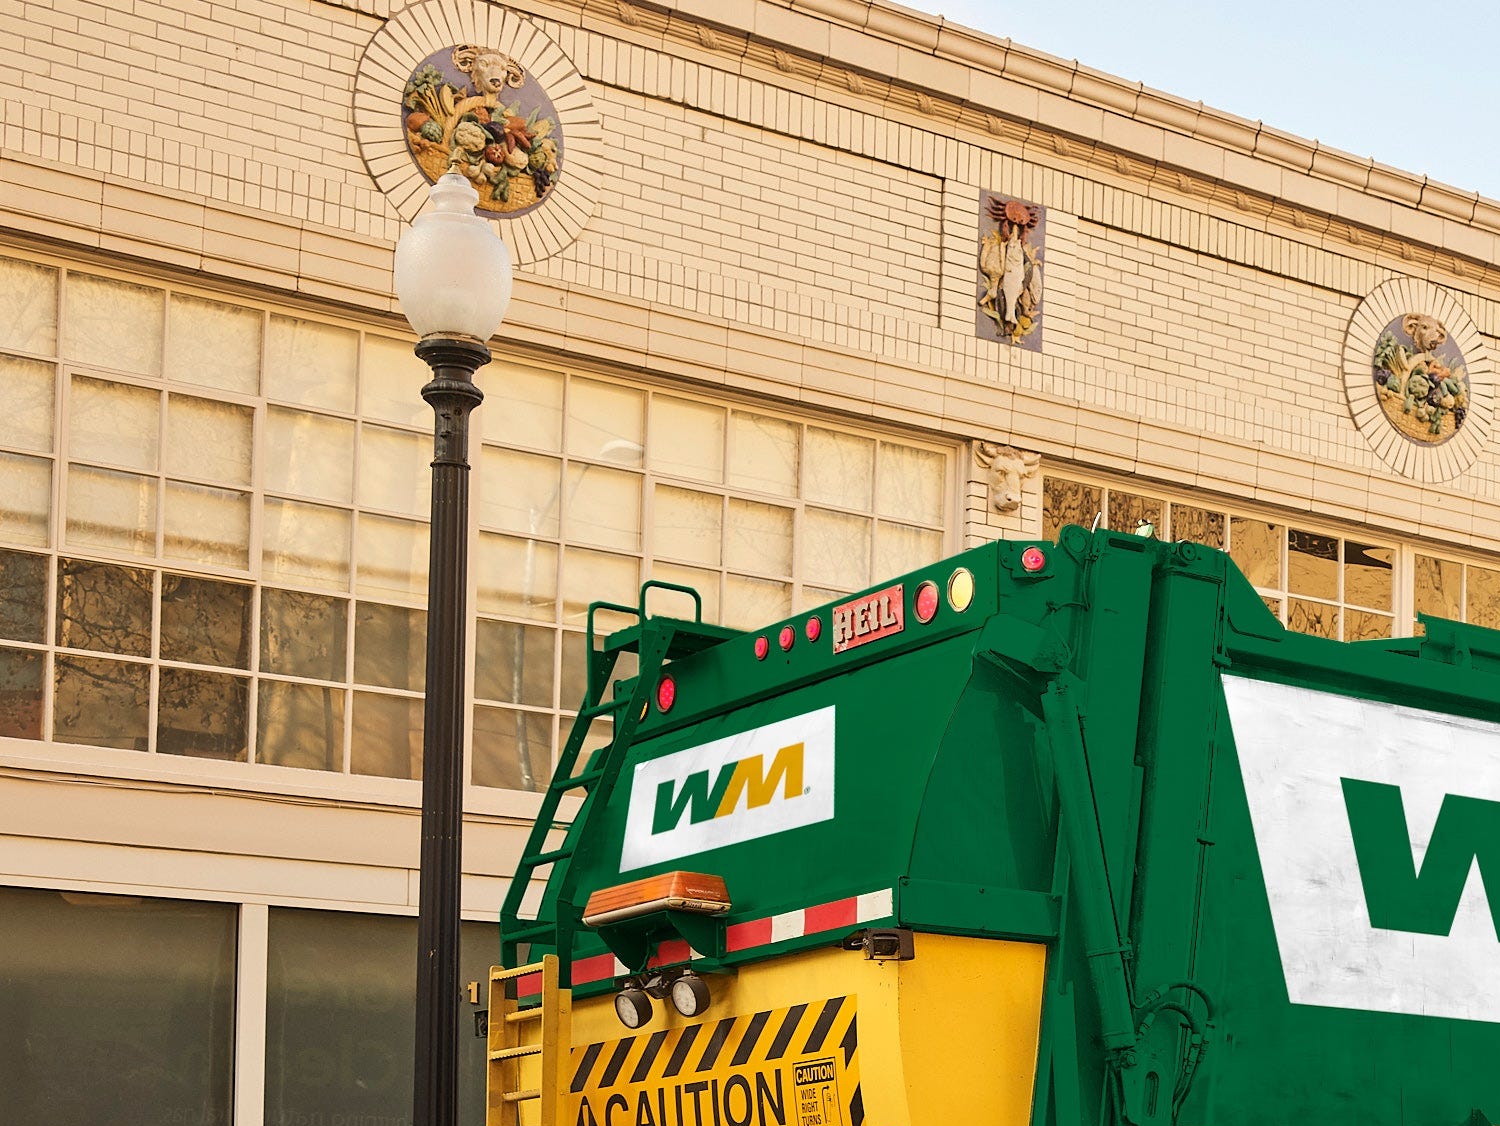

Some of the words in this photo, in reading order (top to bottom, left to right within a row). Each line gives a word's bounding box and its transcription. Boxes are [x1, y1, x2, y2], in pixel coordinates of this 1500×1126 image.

[833, 596, 896, 644] HEIL
[651, 742, 805, 836] WM
[796, 1064, 834, 1083] CAUTION
[801, 1088, 816, 1100] WIDE
[802, 1101, 818, 1114] RIGHT
[802, 1114, 822, 1126] TURNS
